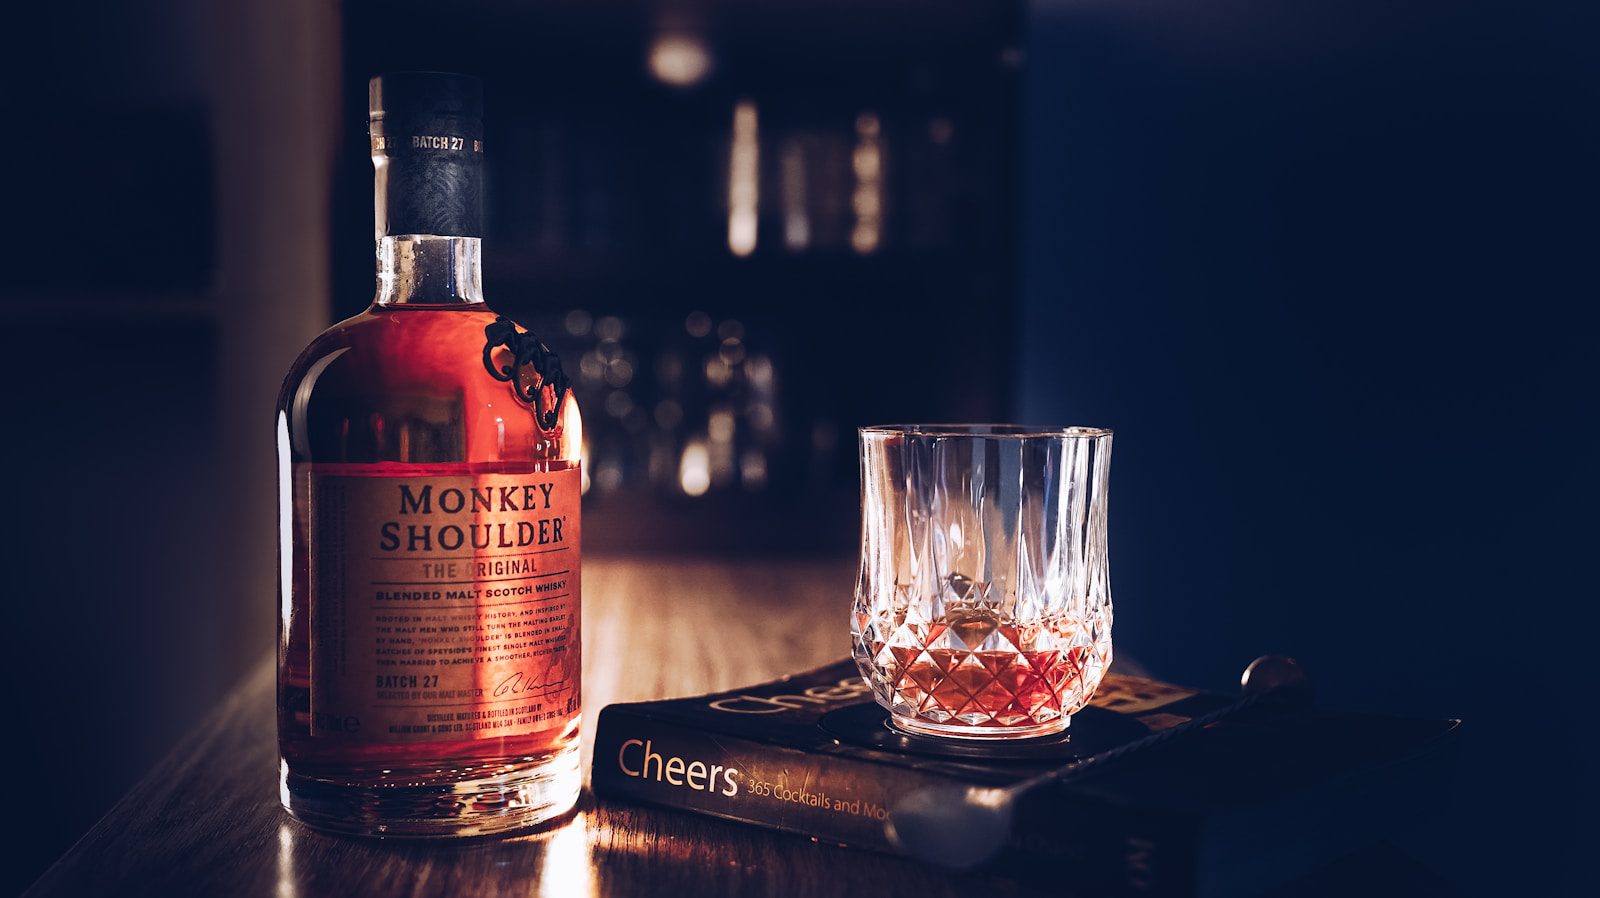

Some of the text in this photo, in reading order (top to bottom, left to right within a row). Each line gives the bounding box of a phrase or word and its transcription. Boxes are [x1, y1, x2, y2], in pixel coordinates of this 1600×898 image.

[412, 136, 448, 150] BATCH
[451, 137, 464, 150] 27
[398, 483, 554, 514] MONKEY
[422, 563, 456, 578] THE
[376, 580, 566, 600] BLENDED MALT SCOTCH WHISKY
[485, 612, 518, 620] HISTORY,
[524, 617, 548, 626] MALTING
[514, 630, 542, 638] BLENDED
[376, 675, 439, 688] BATCH 27
[709, 676, 874, 714] Chee
[619, 739, 738, 797] Cheers
[748, 779, 890, 822] 365 Cocktails and Moc
